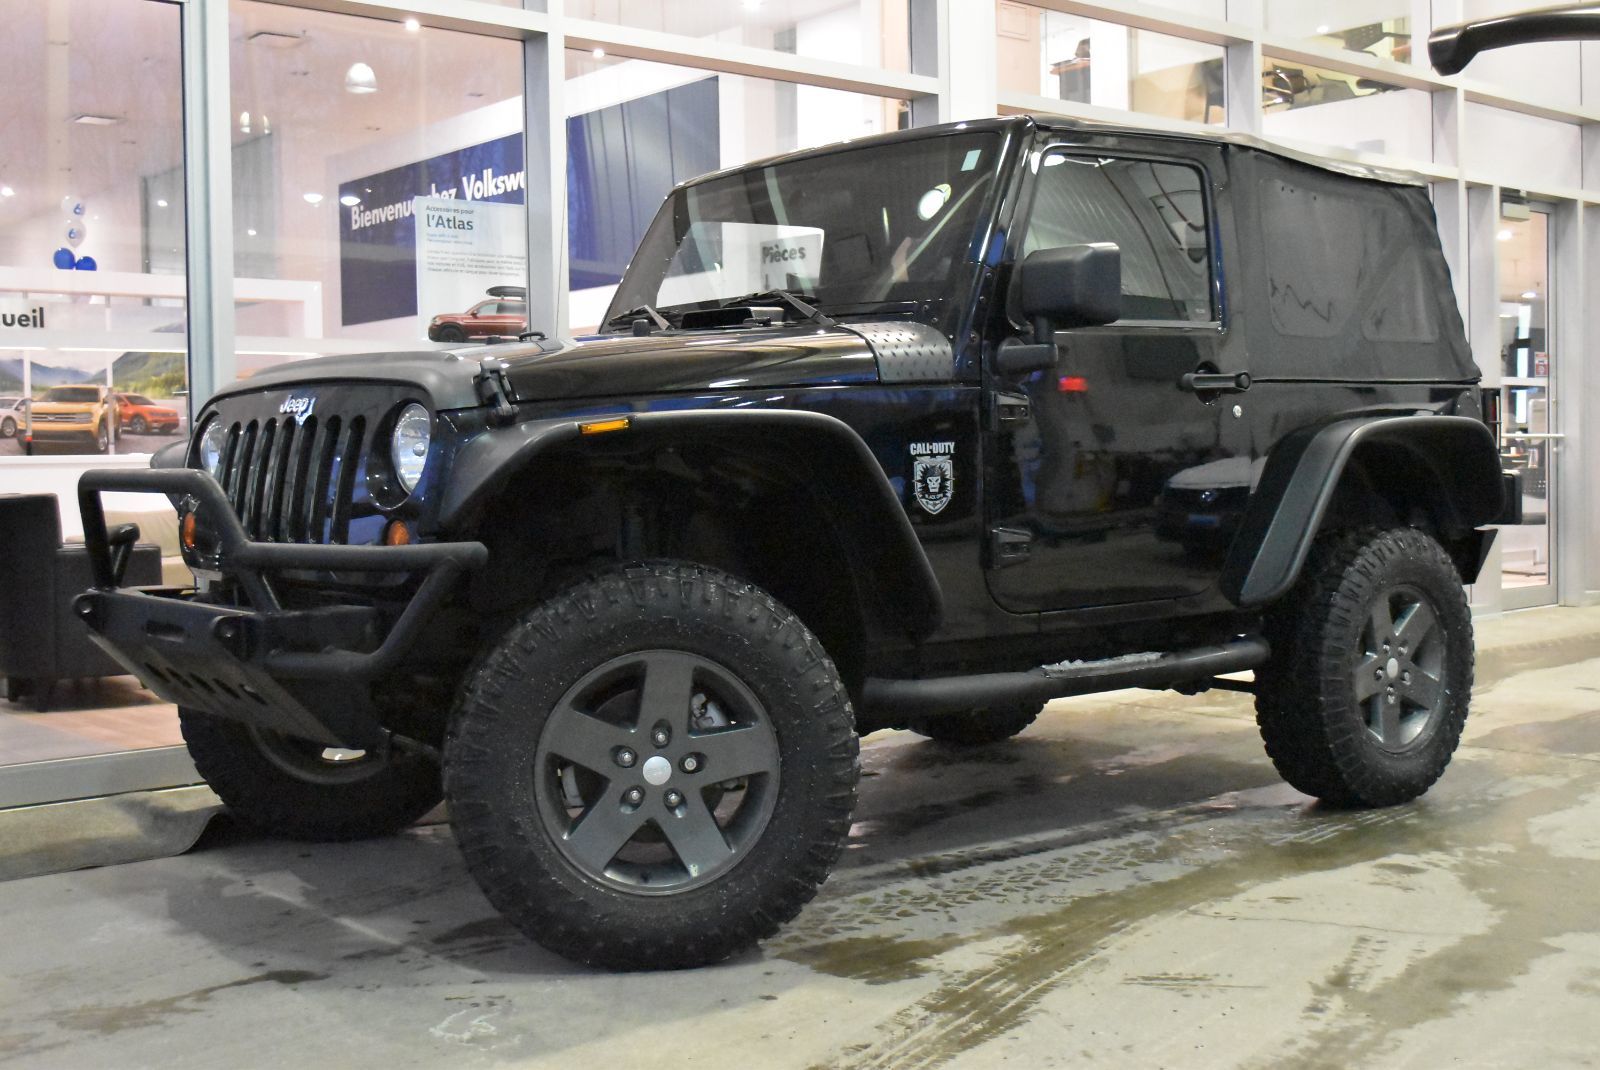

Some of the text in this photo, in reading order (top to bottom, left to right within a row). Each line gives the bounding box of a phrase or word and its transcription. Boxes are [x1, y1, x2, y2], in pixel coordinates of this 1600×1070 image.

[426, 183, 457, 200] hez
[426, 213, 474, 231] l'Atlas
[761, 244, 806, 265] Pièces
[2, 306, 45, 328] ueil
[279, 394, 309, 417] Jeep
[909, 441, 956, 455] CALL DUTY
